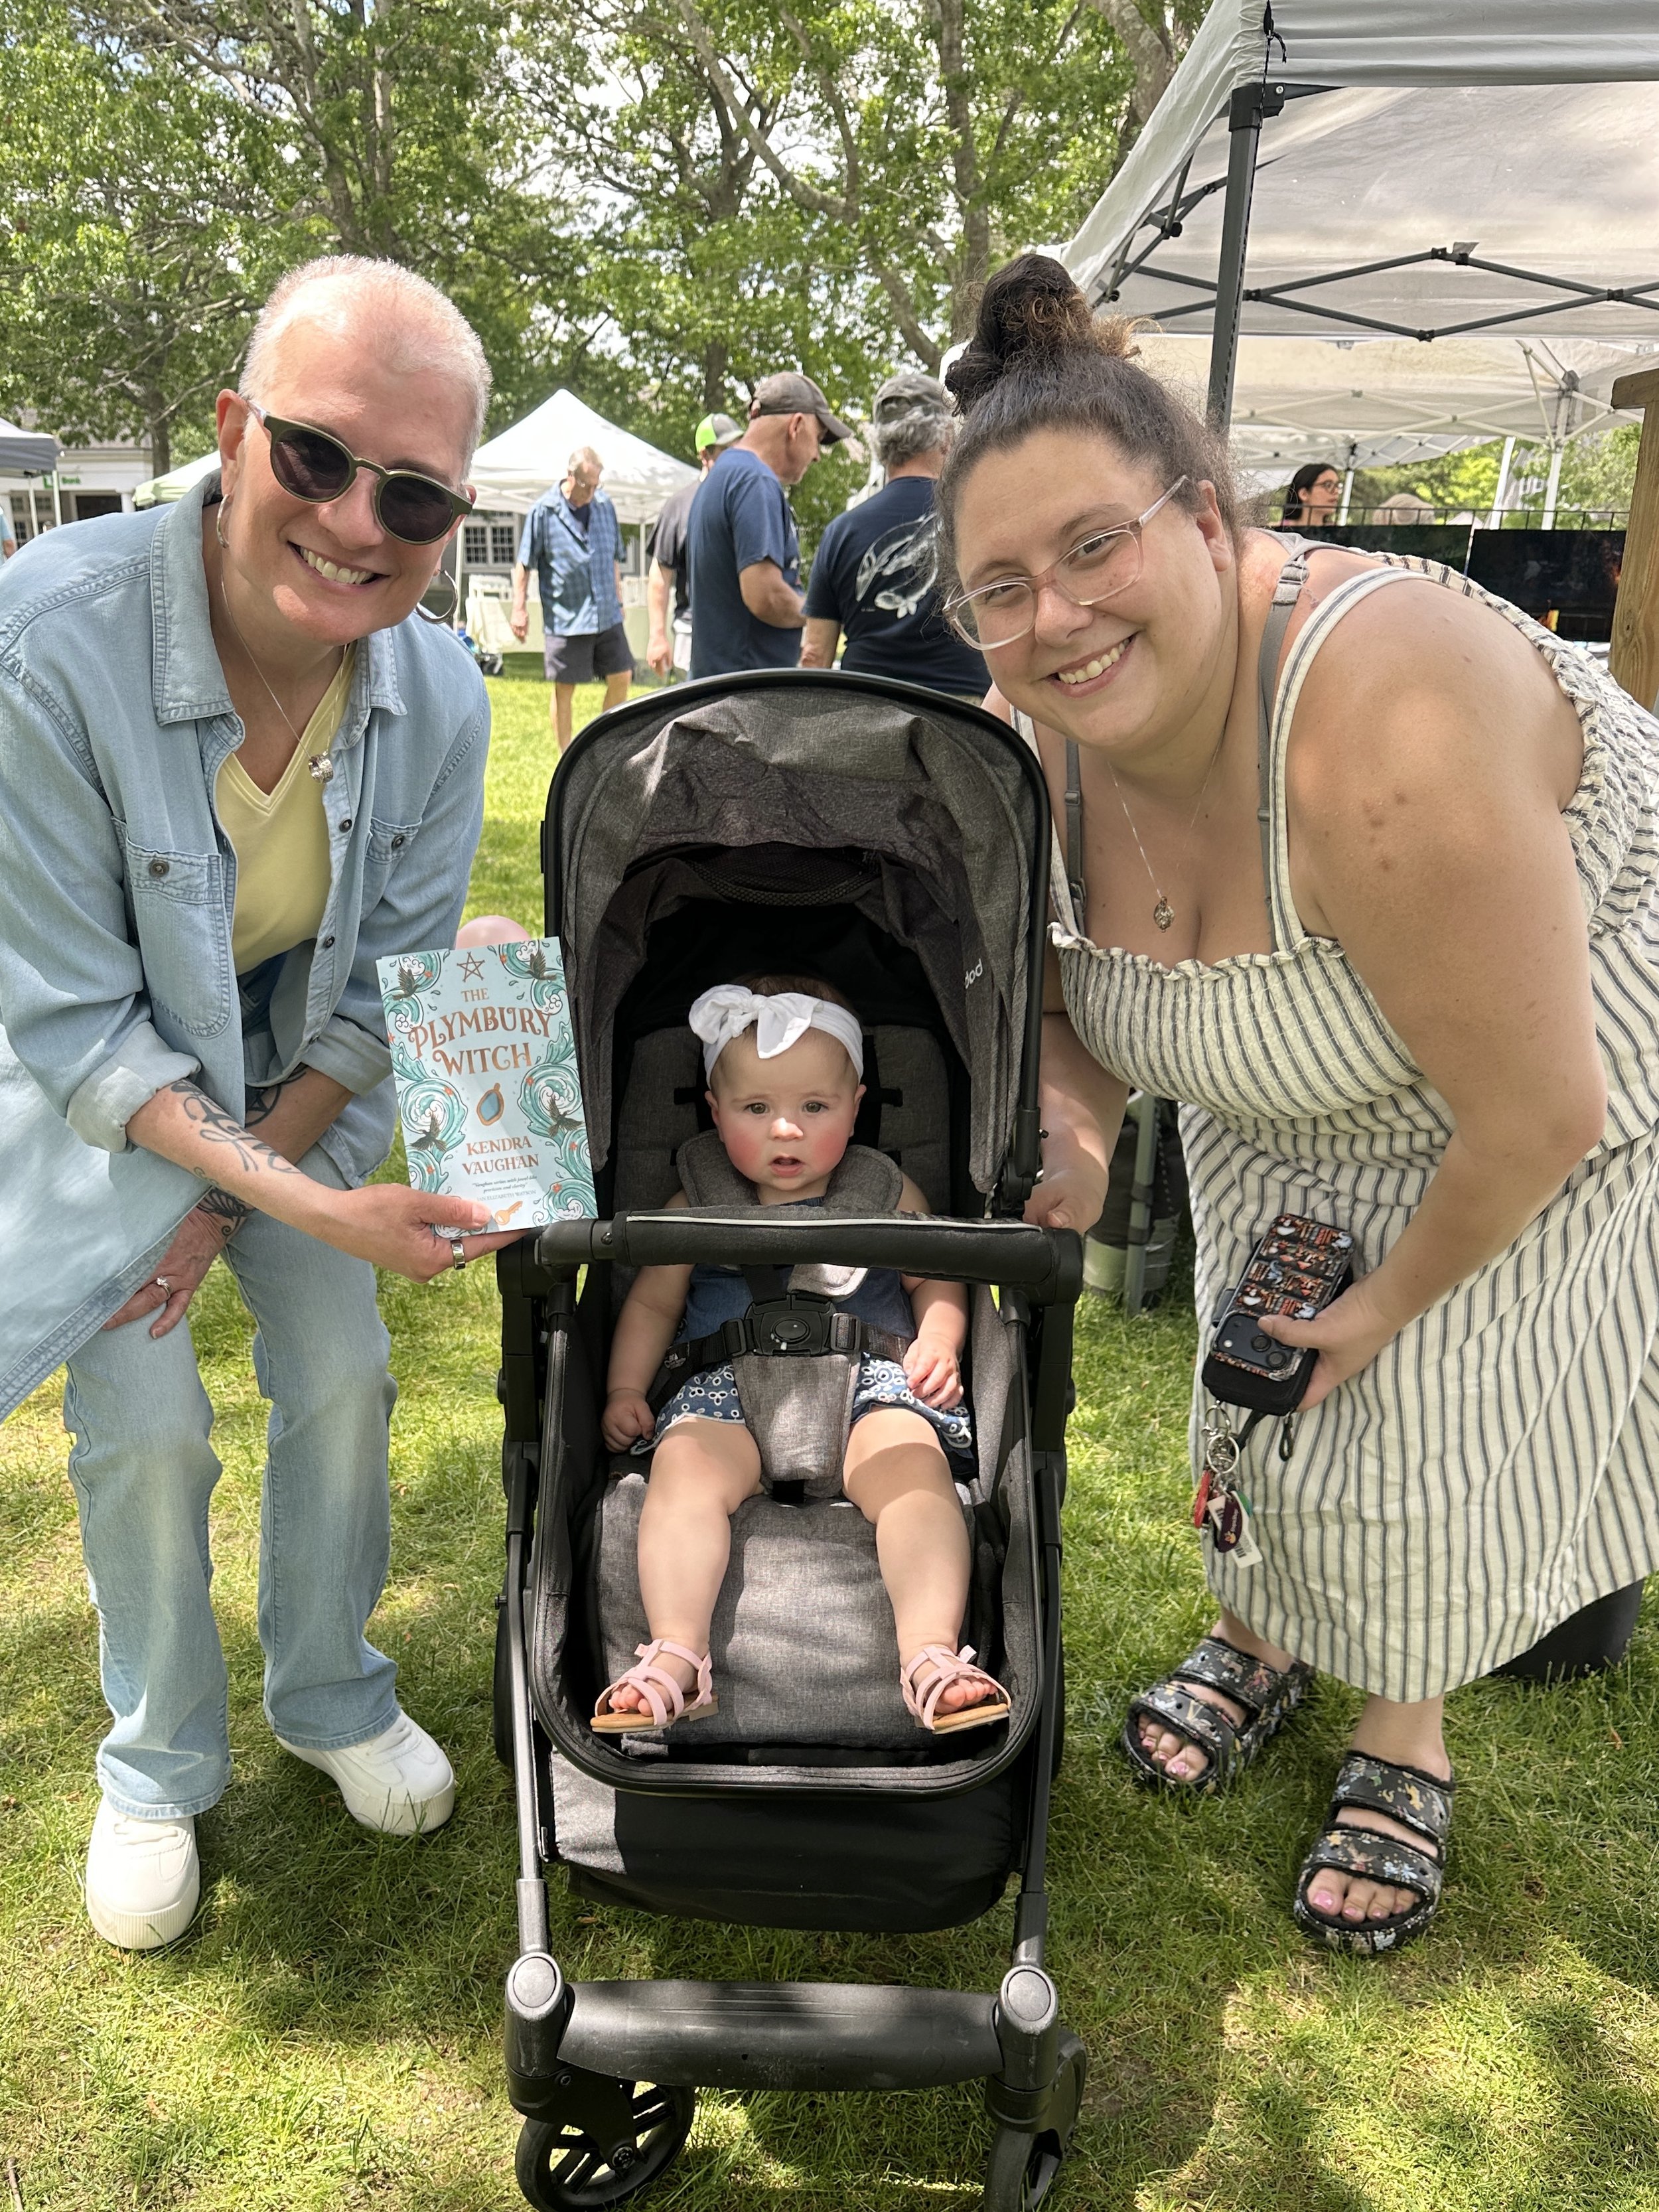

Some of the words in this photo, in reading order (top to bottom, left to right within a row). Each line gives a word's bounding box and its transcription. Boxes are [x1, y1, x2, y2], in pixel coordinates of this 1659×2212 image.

[461, 988, 490, 1002] THE
[408, 1006, 553, 1058] PLYMBURY
[432, 1043, 532, 1076] WITCH
[467, 1136, 532, 1155] KENDRA
[462, 1153, 539, 1175] VAUGHAN
